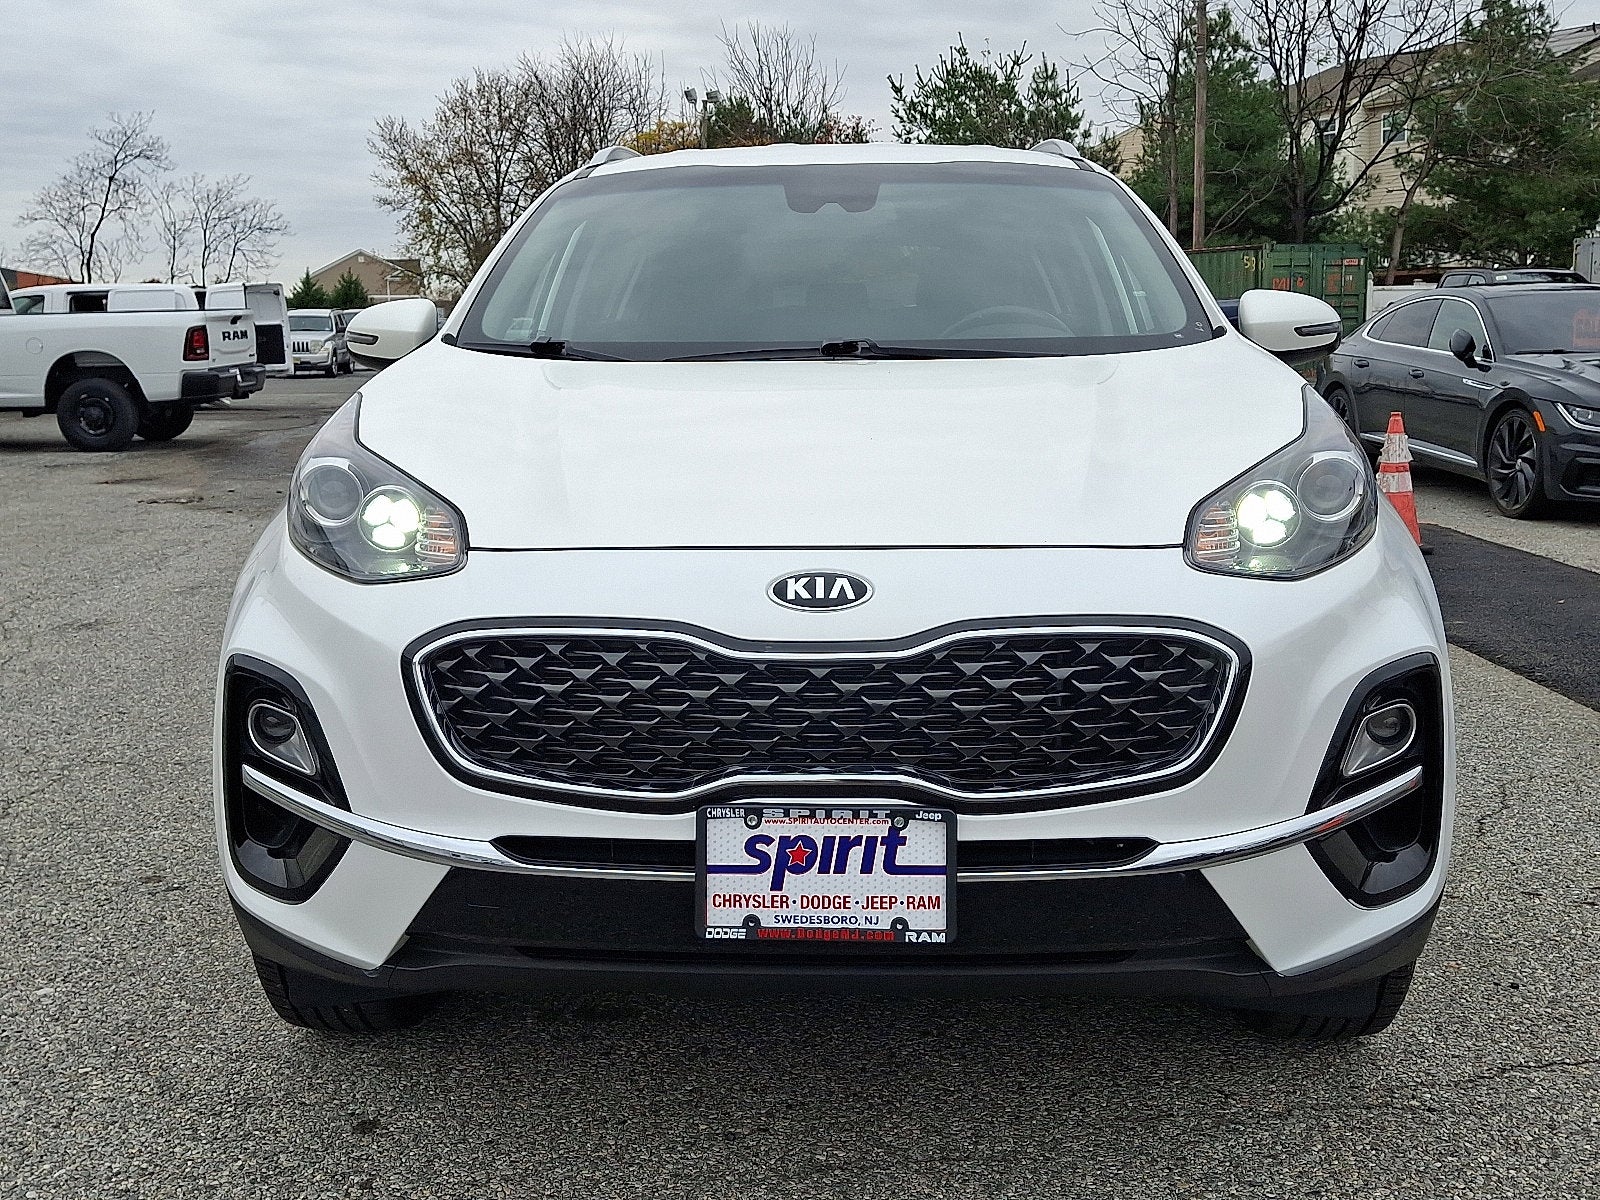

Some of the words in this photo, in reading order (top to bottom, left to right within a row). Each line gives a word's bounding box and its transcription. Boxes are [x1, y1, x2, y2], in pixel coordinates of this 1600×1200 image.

[222, 330, 248, 341] RAM
[786, 576, 856, 600] KIA
[706, 808, 745, 818] CHRYSLER
[762, 808, 890, 818] SPIRIT
[915, 811, 942, 821] Jeep
[744, 826, 907, 891] spirit
[712, 894, 790, 909] CHRYSLER
[800, 895, 851, 909] DODGE
[861, 896, 898, 910] JEEP
[906, 896, 941, 910] RAM
[773, 914, 861, 926] SWEDESBORO,
[864, 915, 880, 925] NJ
[706, 928, 746, 939] DODGE
[757, 928, 896, 941] www.DodgeNJ.com
[905, 931, 946, 943] RAM
